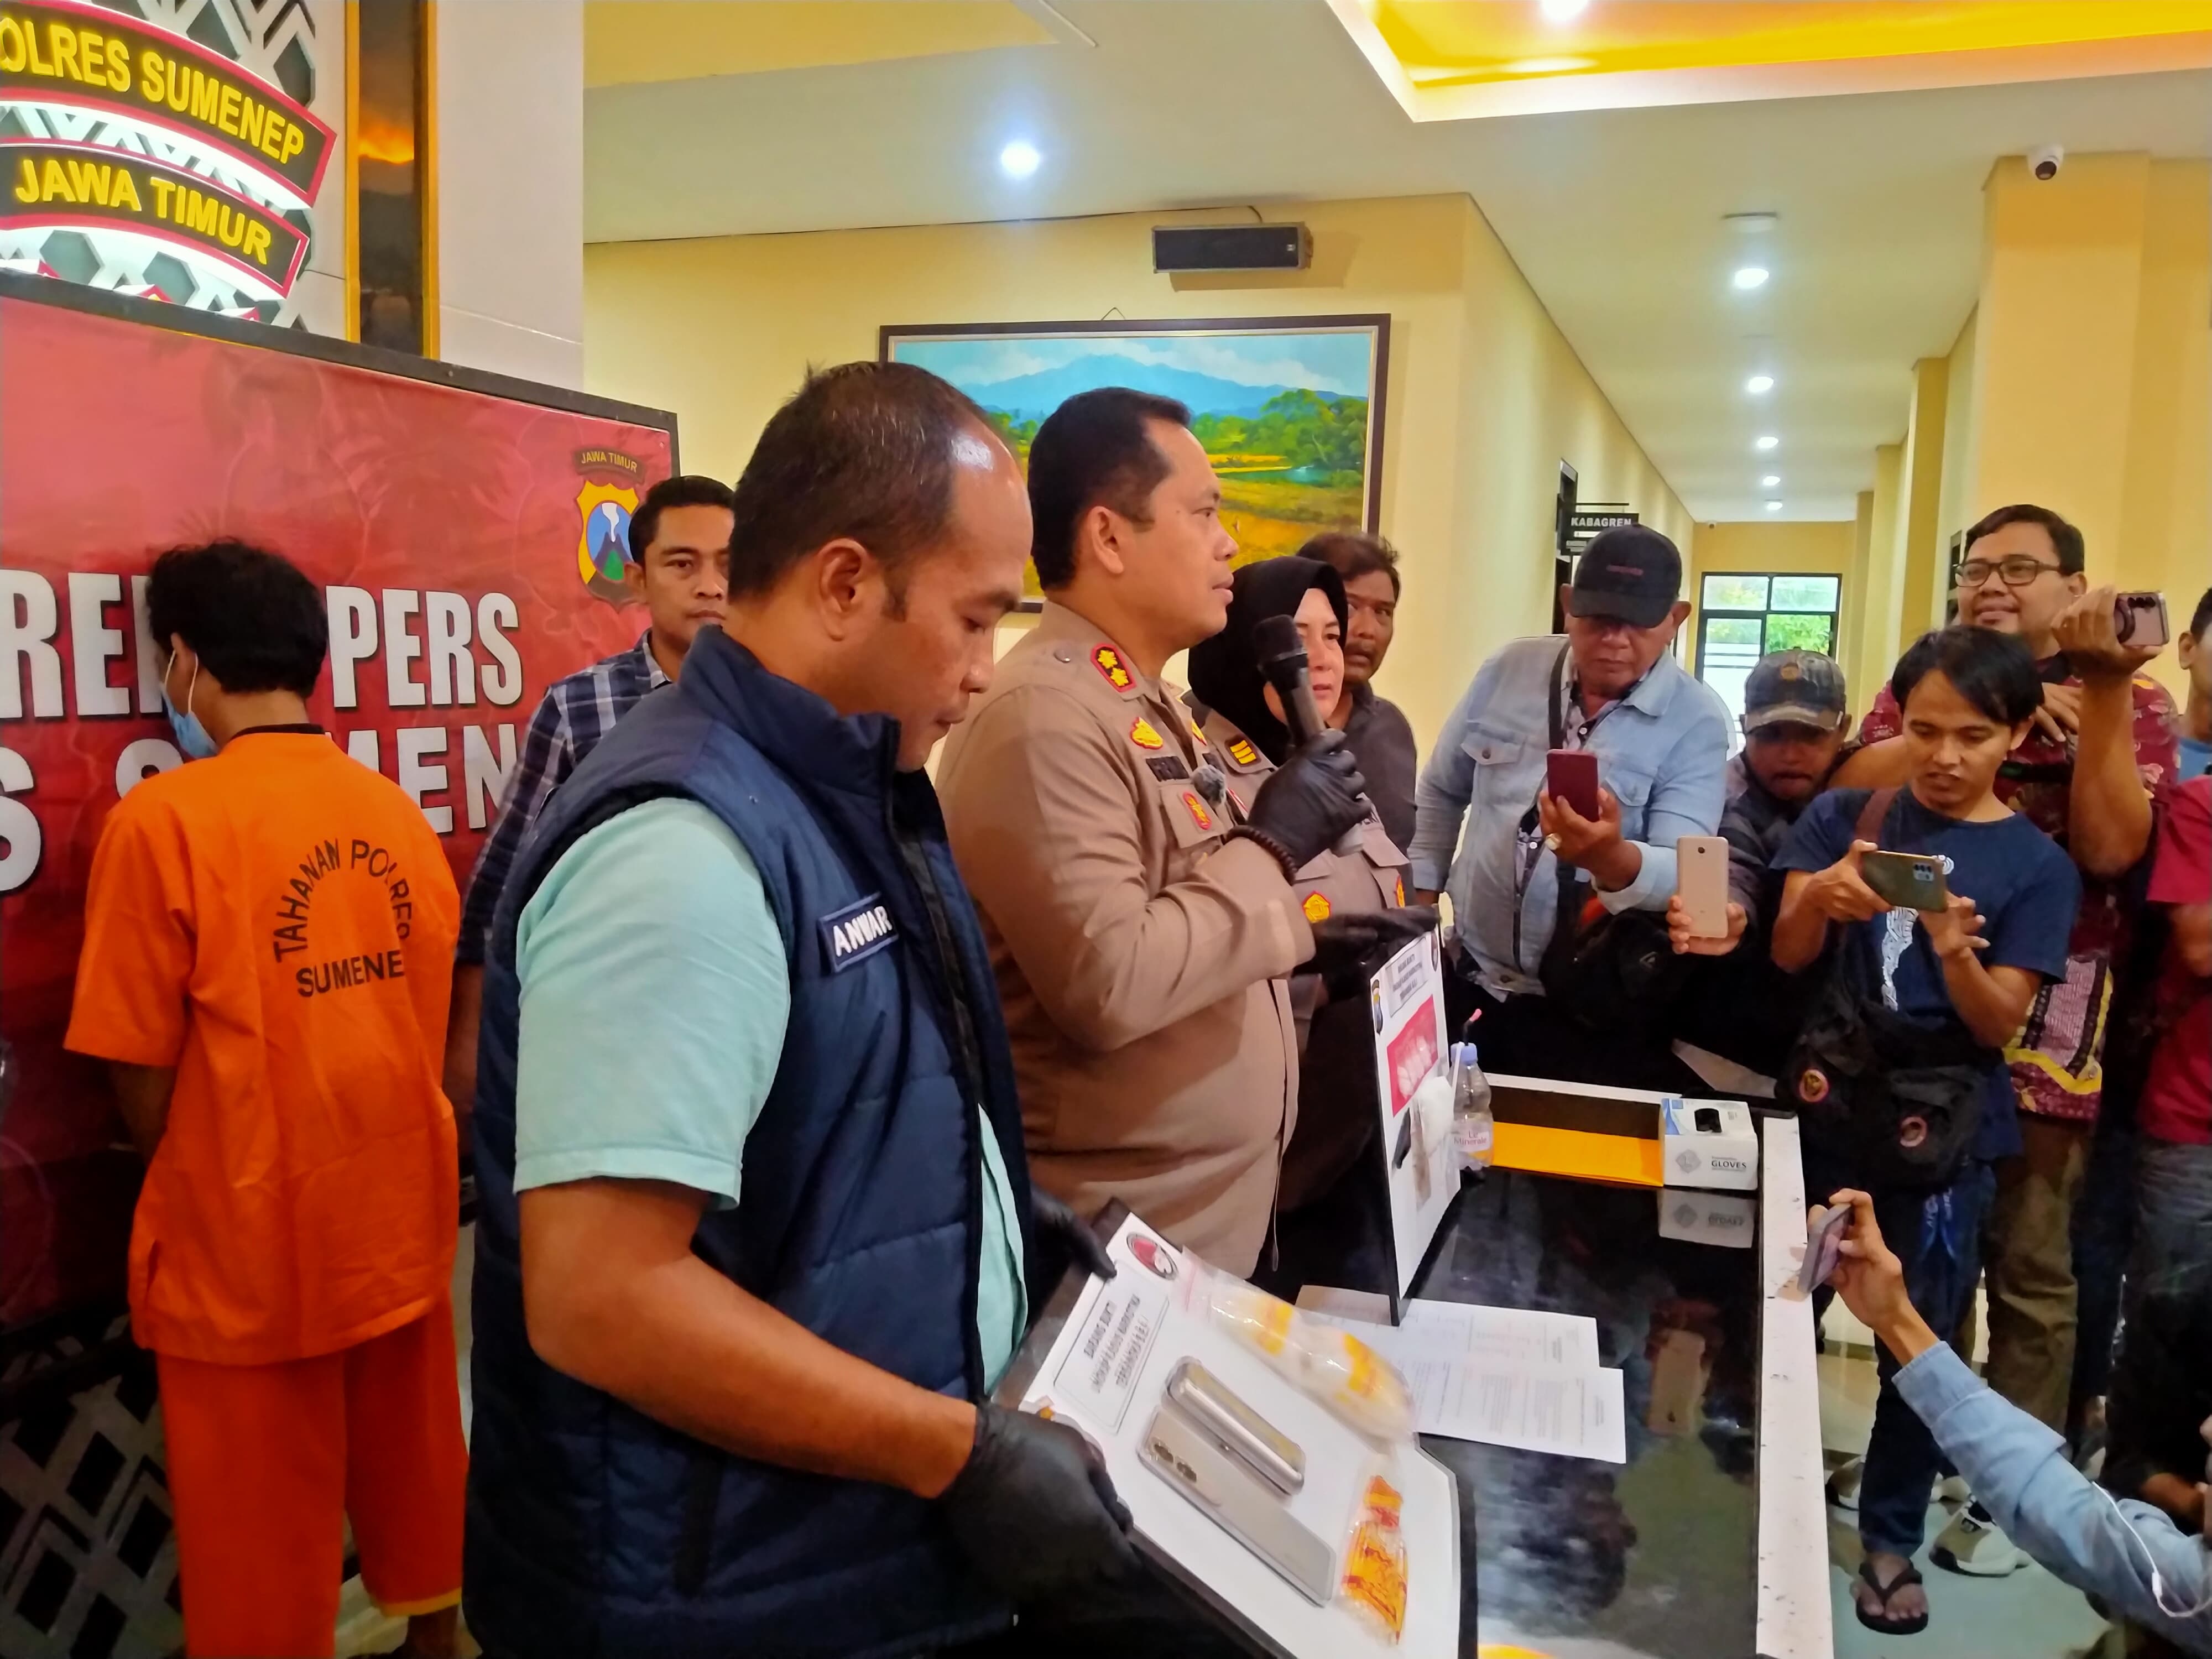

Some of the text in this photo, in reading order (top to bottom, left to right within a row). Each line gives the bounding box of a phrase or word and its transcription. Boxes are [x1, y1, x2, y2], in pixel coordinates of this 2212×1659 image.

[142, 51, 304, 164] SUMENEP
[15, 160, 271, 264] JAWA TIMUR
[581, 451, 638, 473] JAWA TIMUR
[326, 585, 522, 707] PERS
[273, 838, 340, 963] TAHANAN
[1712, 1160, 1747, 1168] GLOVES
